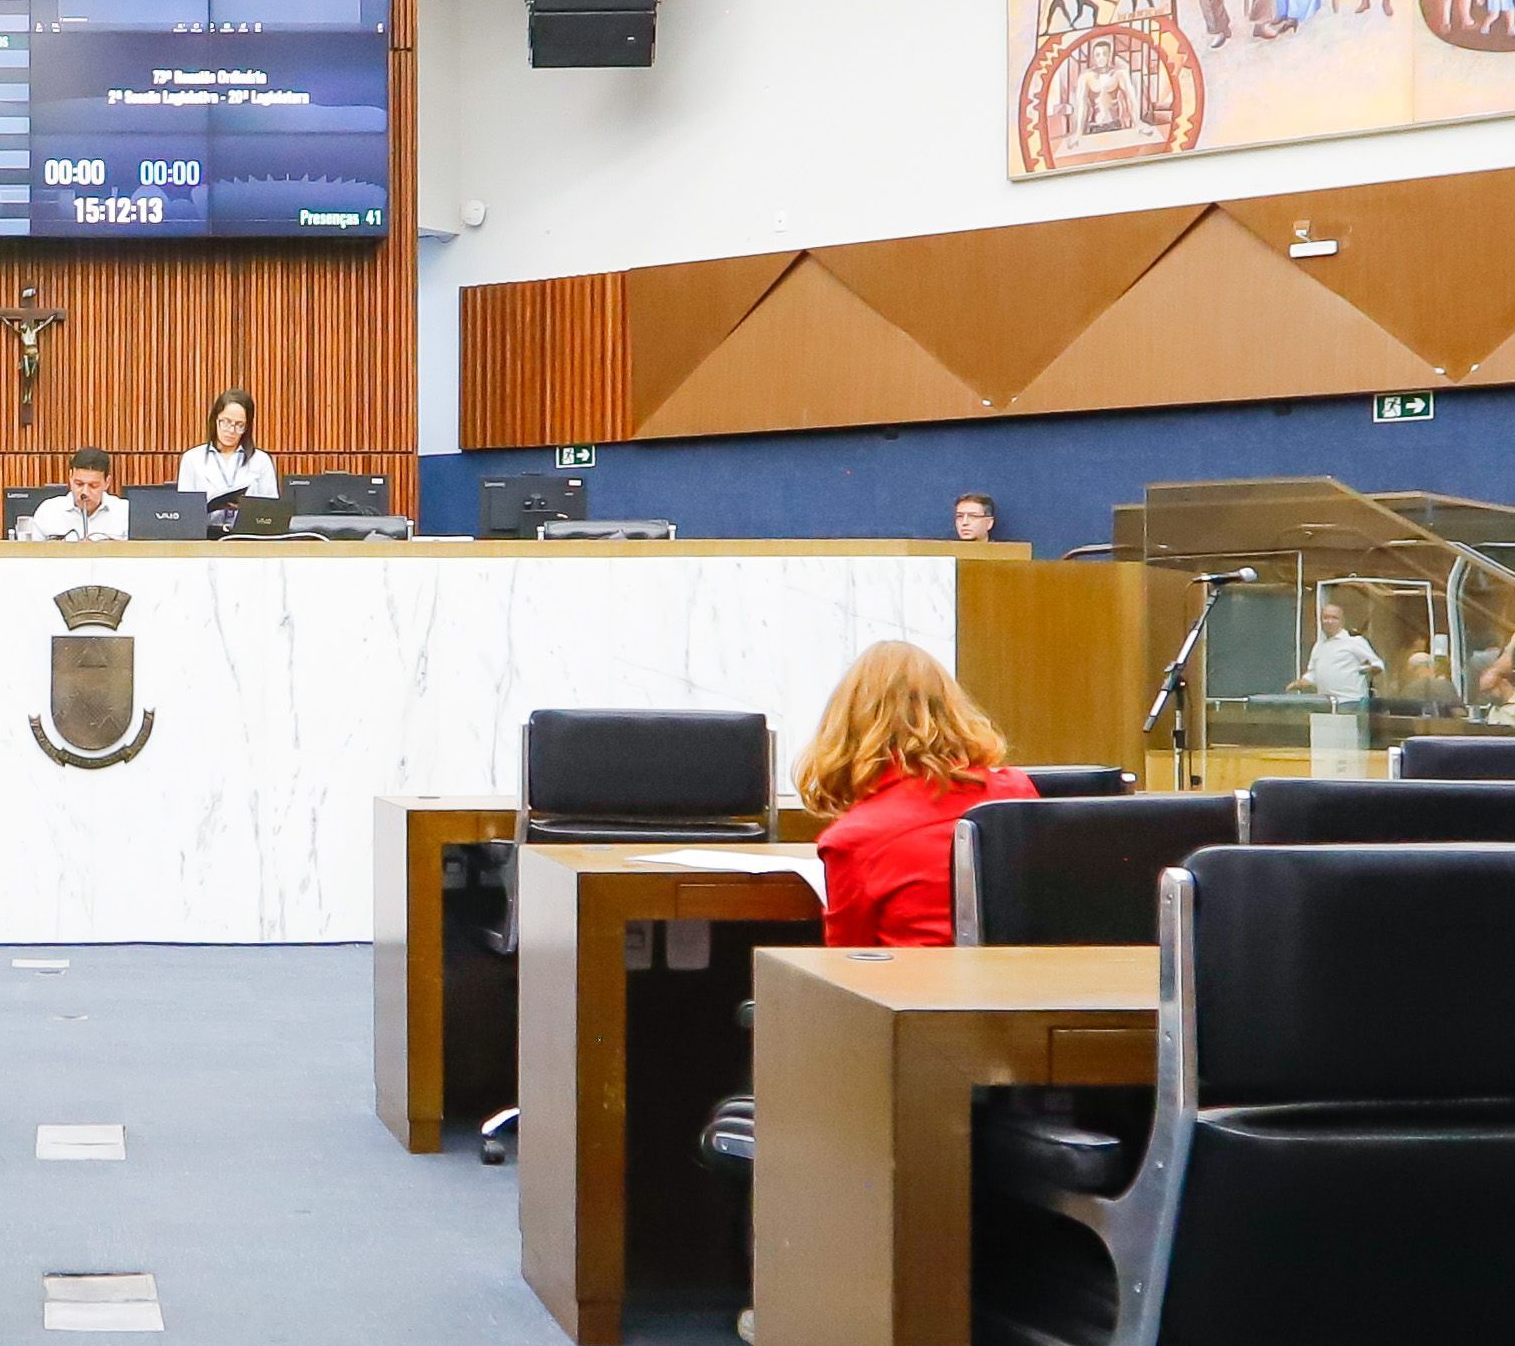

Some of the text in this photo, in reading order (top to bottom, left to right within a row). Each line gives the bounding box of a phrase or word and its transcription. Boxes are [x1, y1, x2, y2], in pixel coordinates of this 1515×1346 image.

[217, 69, 268, 84] Ordinária
[162, 90, 218, 105] Legislativa
[251, 90, 310, 106] Legislatura
[44, 159, 105, 185] 00:00
[139, 160, 201, 186] 00:00
[73, 197, 163, 224] 15:12:13
[300, 210, 382, 229] Presenças 41
